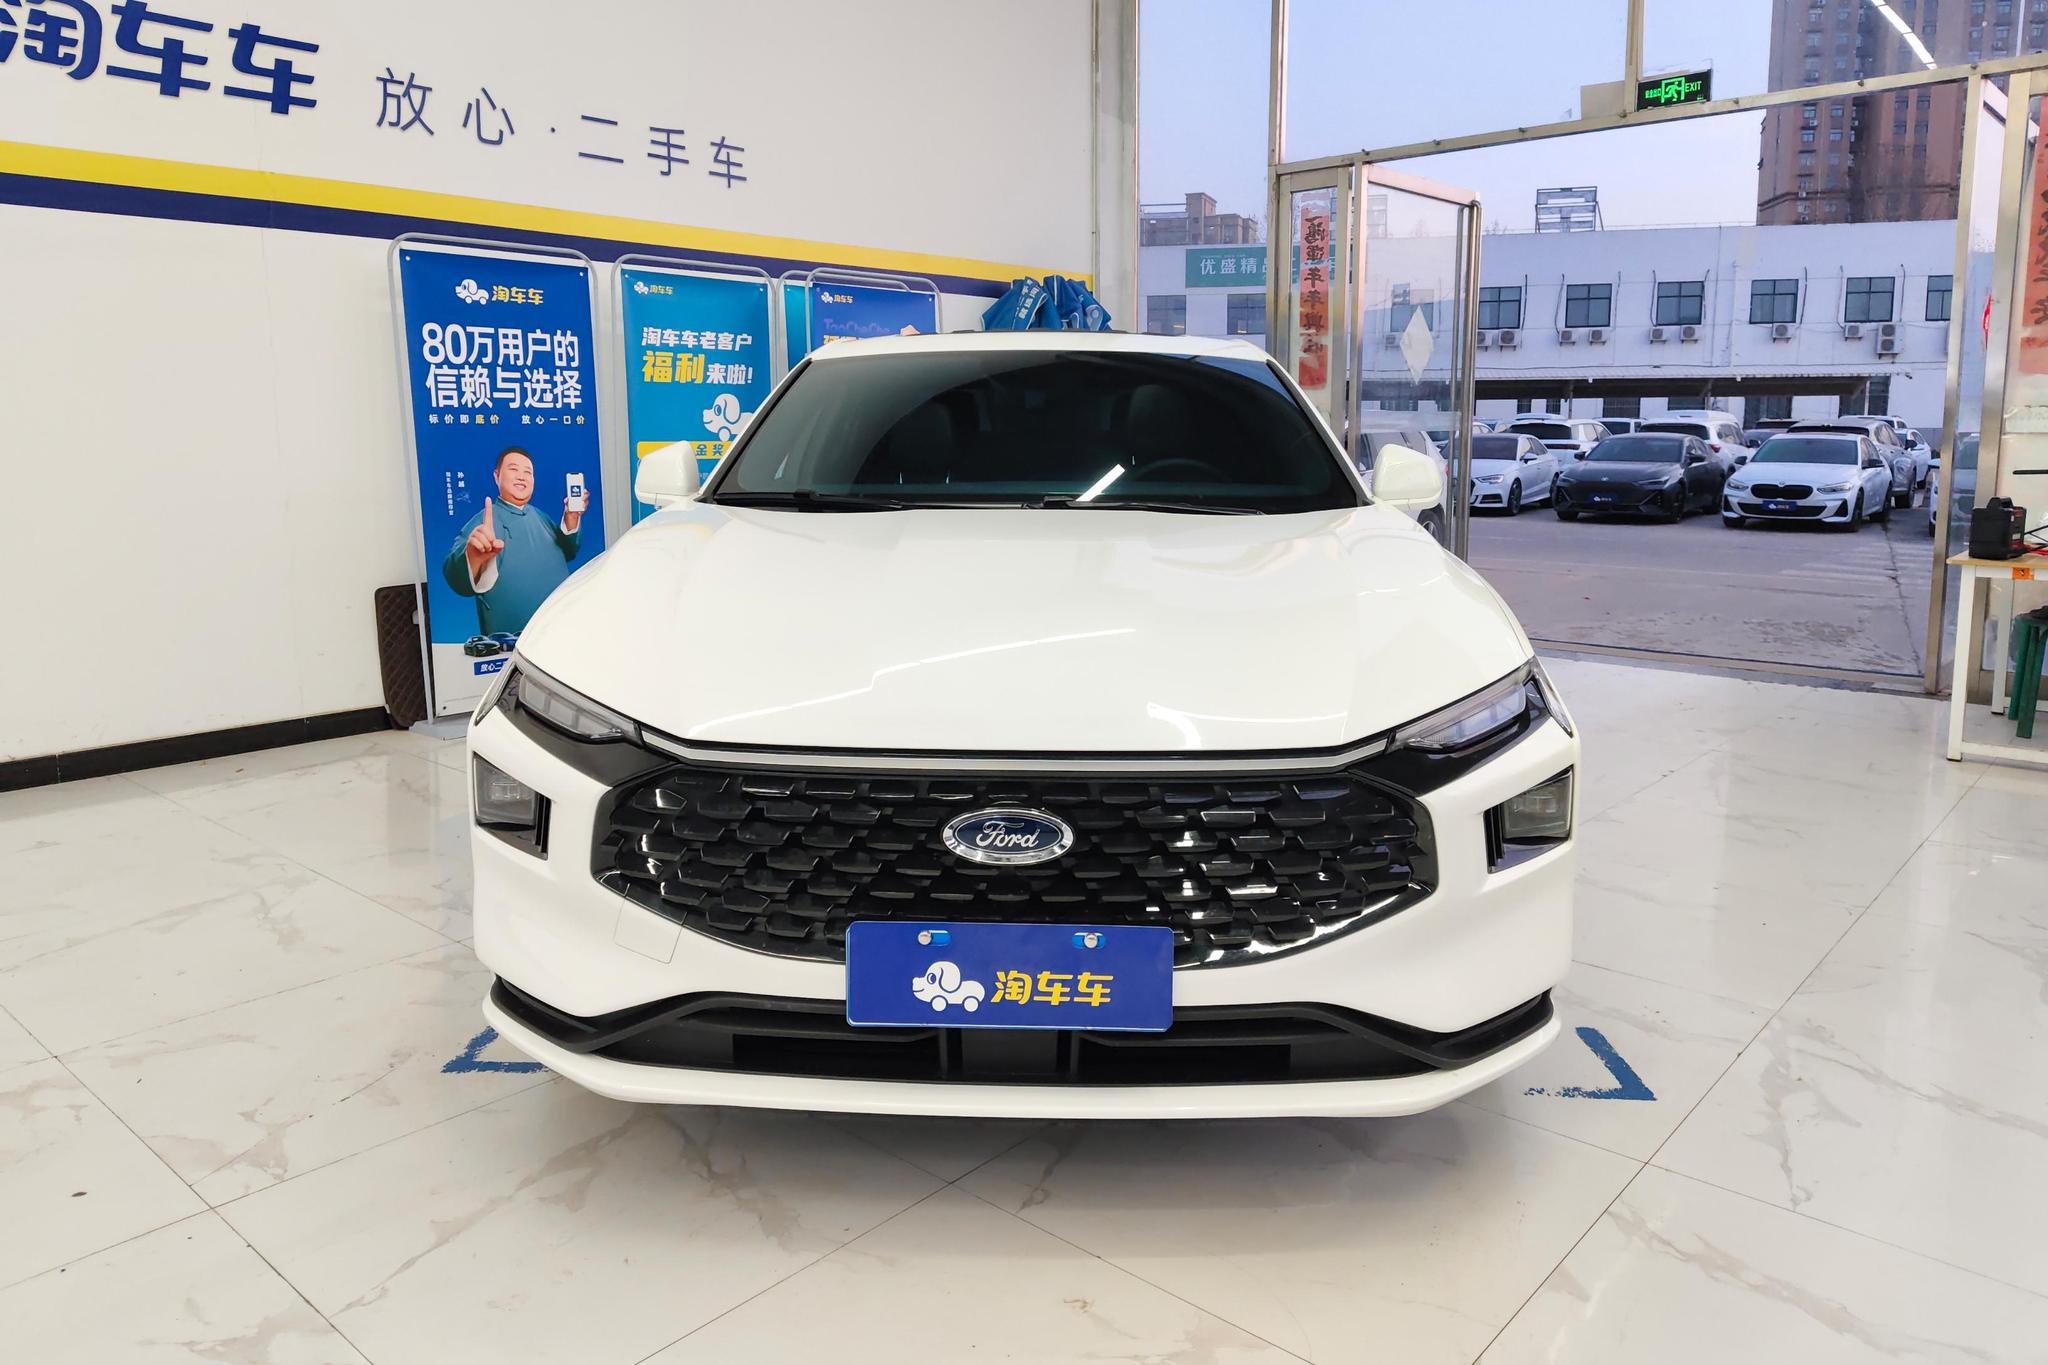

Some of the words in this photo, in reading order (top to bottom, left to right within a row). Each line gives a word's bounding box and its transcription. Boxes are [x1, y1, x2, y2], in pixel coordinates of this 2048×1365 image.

[0, 0, 320, 115] 淘车车
[1685, 80, 1702, 93] EXIT
[491, 285, 544, 305] 淘车车
[421, 322, 580, 368] 80万用户的
[641, 326, 753, 352] 淘车车老客户
[425, 364, 583, 410] 信赖与选择
[428, 413, 500, 425] 标价即底价
[521, 414, 585, 425] 放心一口价
[975, 820, 1040, 848] Ford
[990, 970, 1114, 1007] 淘车车
